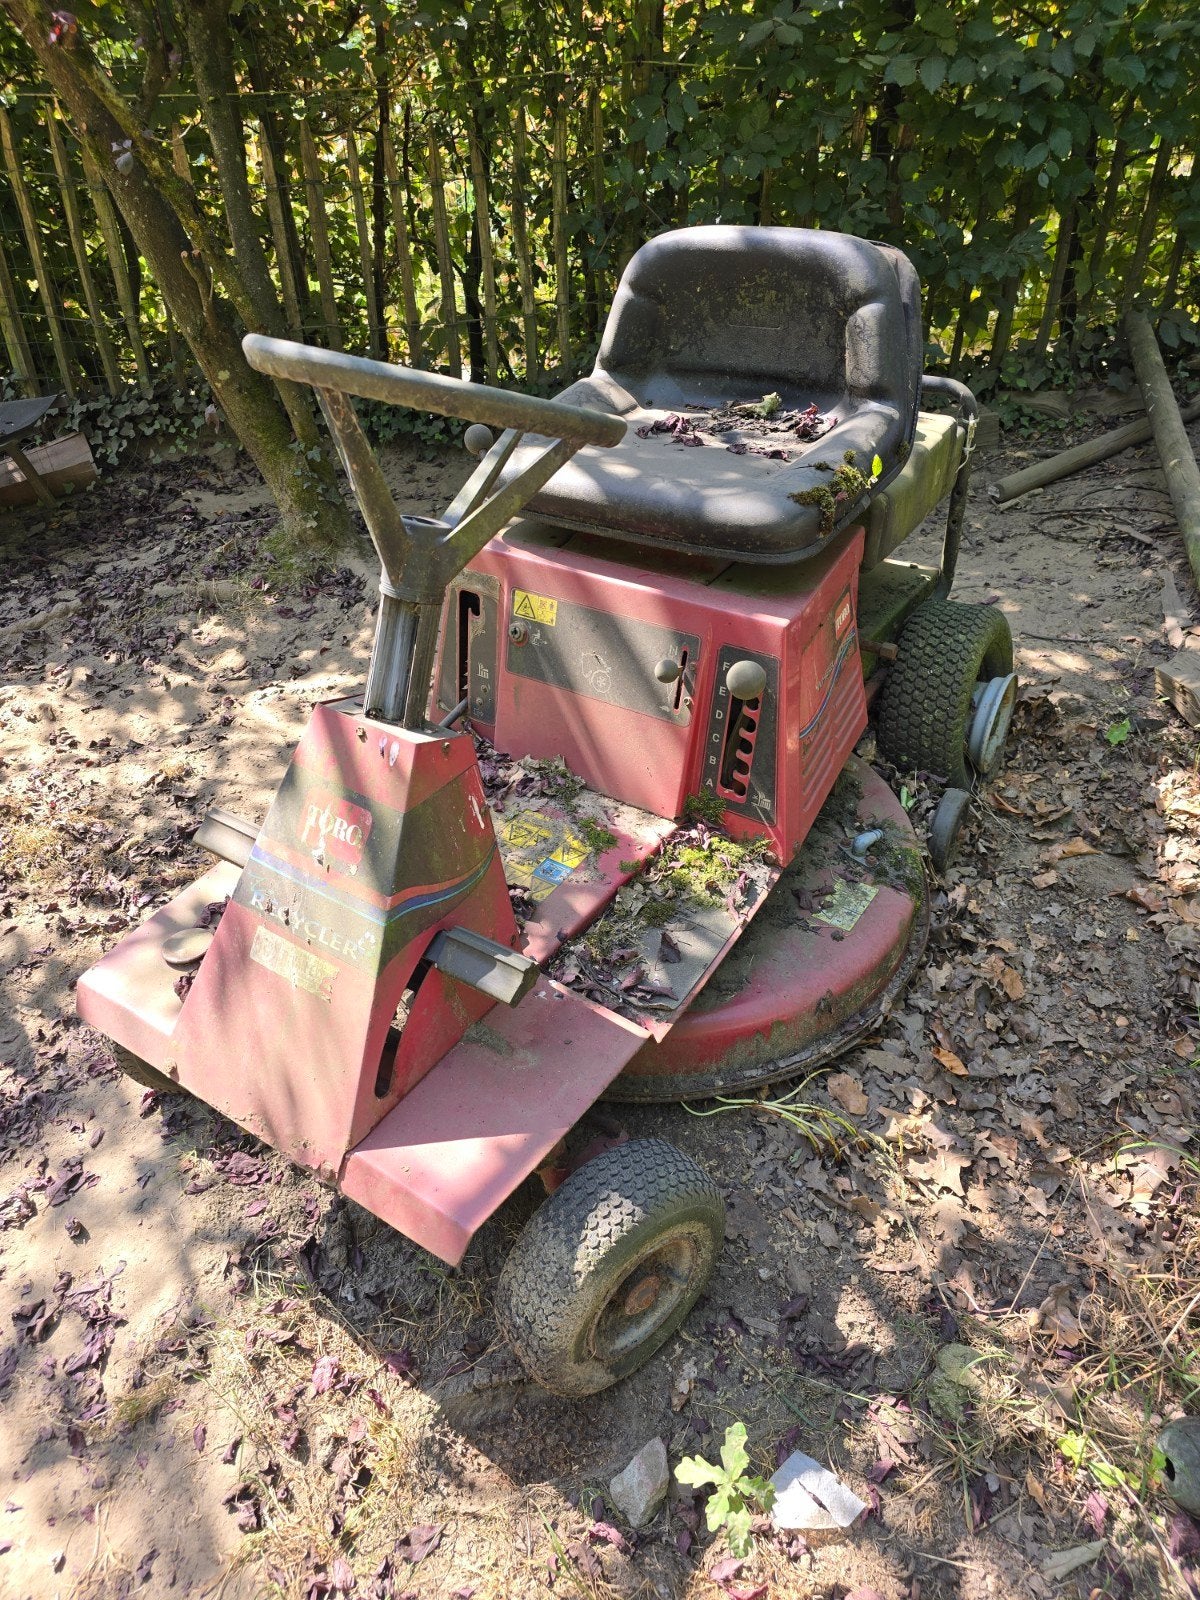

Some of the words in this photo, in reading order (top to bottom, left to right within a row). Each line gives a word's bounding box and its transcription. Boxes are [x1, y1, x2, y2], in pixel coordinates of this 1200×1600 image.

[722, 661, 730, 671] F
[718, 686, 726, 696] E
[715, 710, 723, 719] D
[712, 734, 720, 743] C
[709, 755, 717, 765] B
[705, 778, 714, 787] A
[304, 803, 363, 846] TORO
